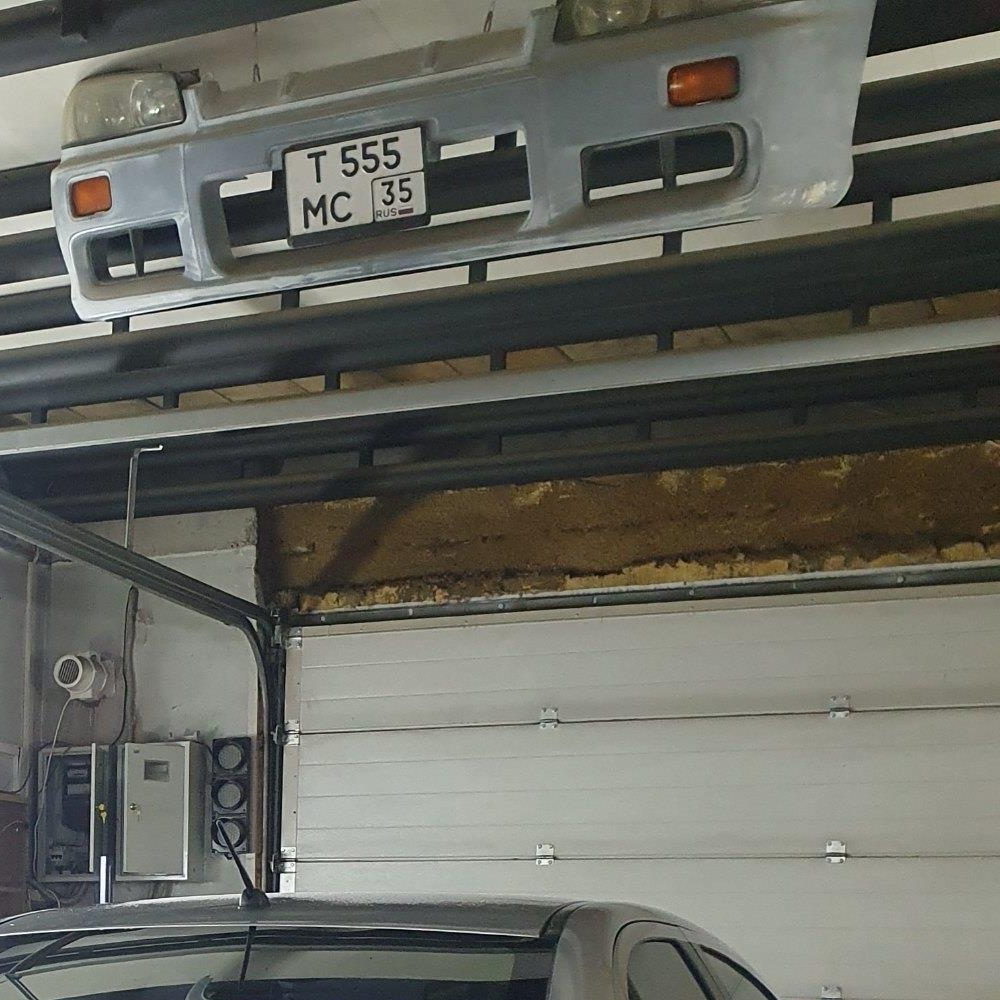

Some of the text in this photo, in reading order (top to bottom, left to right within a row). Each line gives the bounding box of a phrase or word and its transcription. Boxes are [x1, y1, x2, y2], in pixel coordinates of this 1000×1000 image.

[340, 136, 401, 177] 555
[381, 177, 413, 206] 35
[302, 191, 353, 229] МС
[375, 207, 398, 219] RUS
